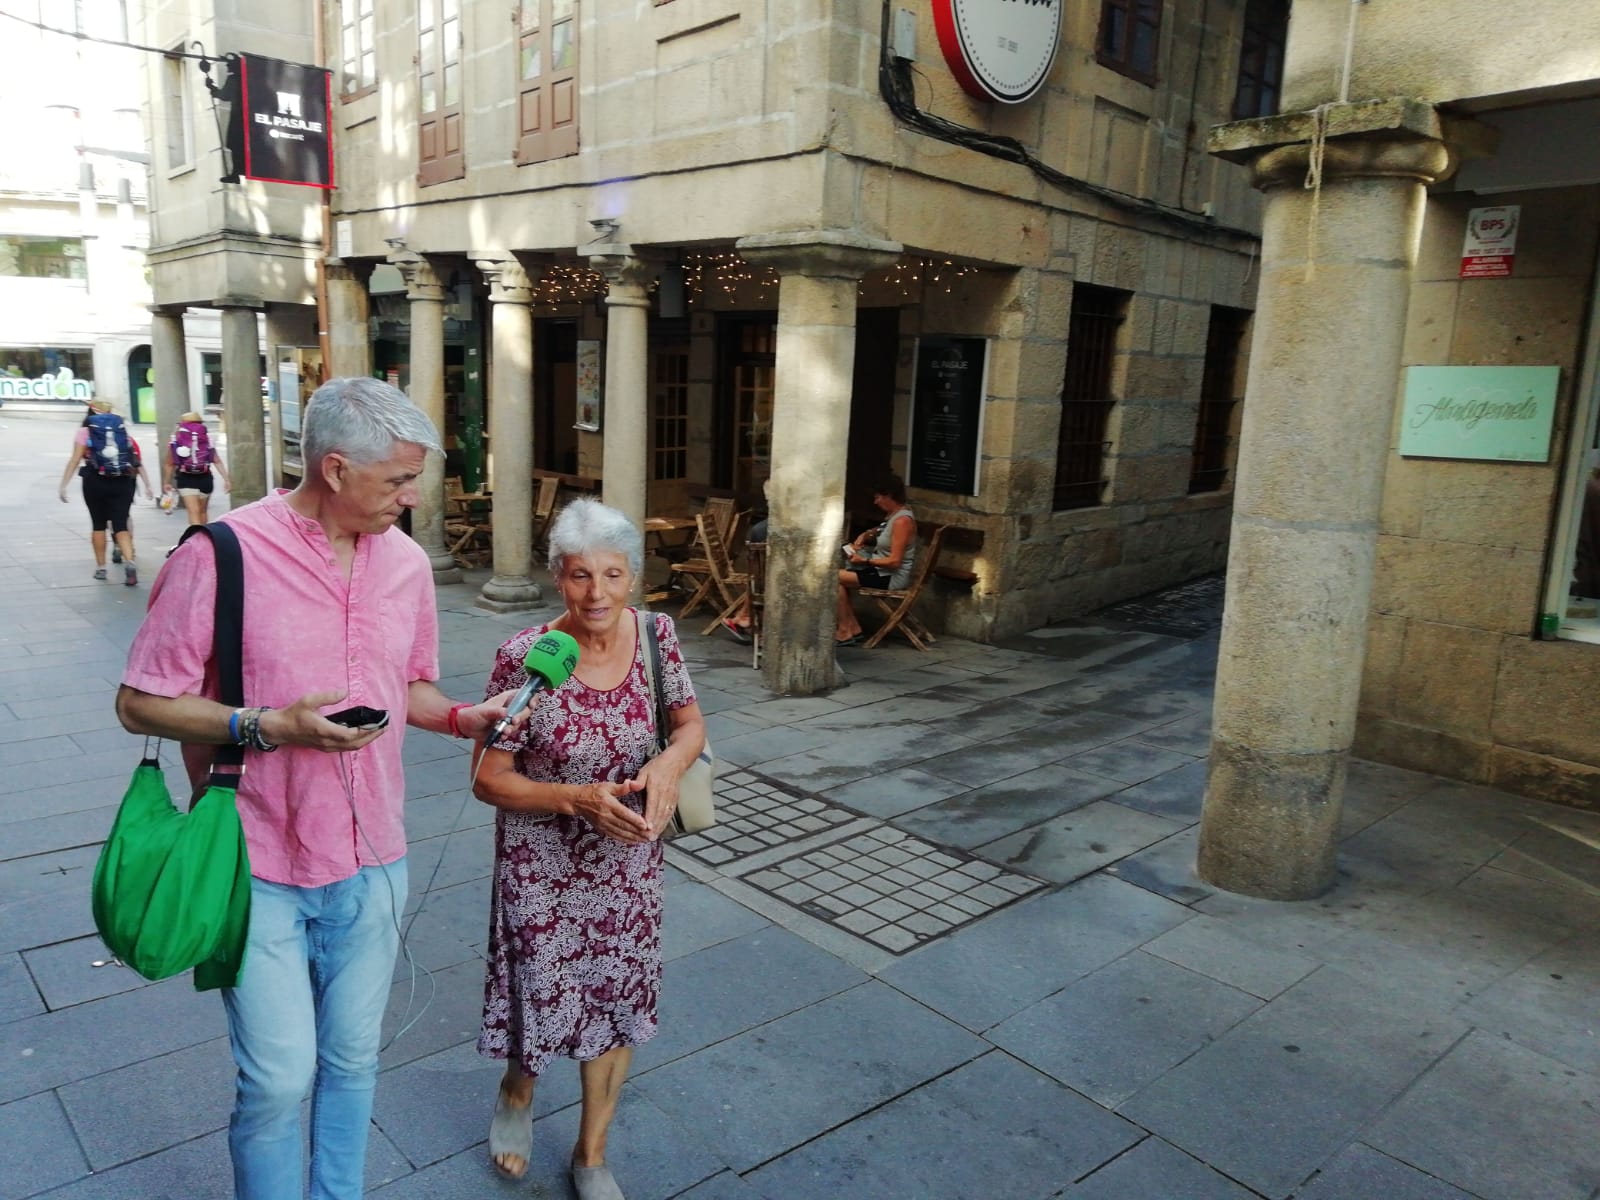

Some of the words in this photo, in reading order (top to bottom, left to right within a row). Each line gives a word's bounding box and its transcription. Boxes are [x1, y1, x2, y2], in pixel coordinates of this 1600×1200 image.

[254, 112, 273, 126] EL
[273, 115, 322, 133] PASAJE
[1480, 218, 1505, 231] BPS
